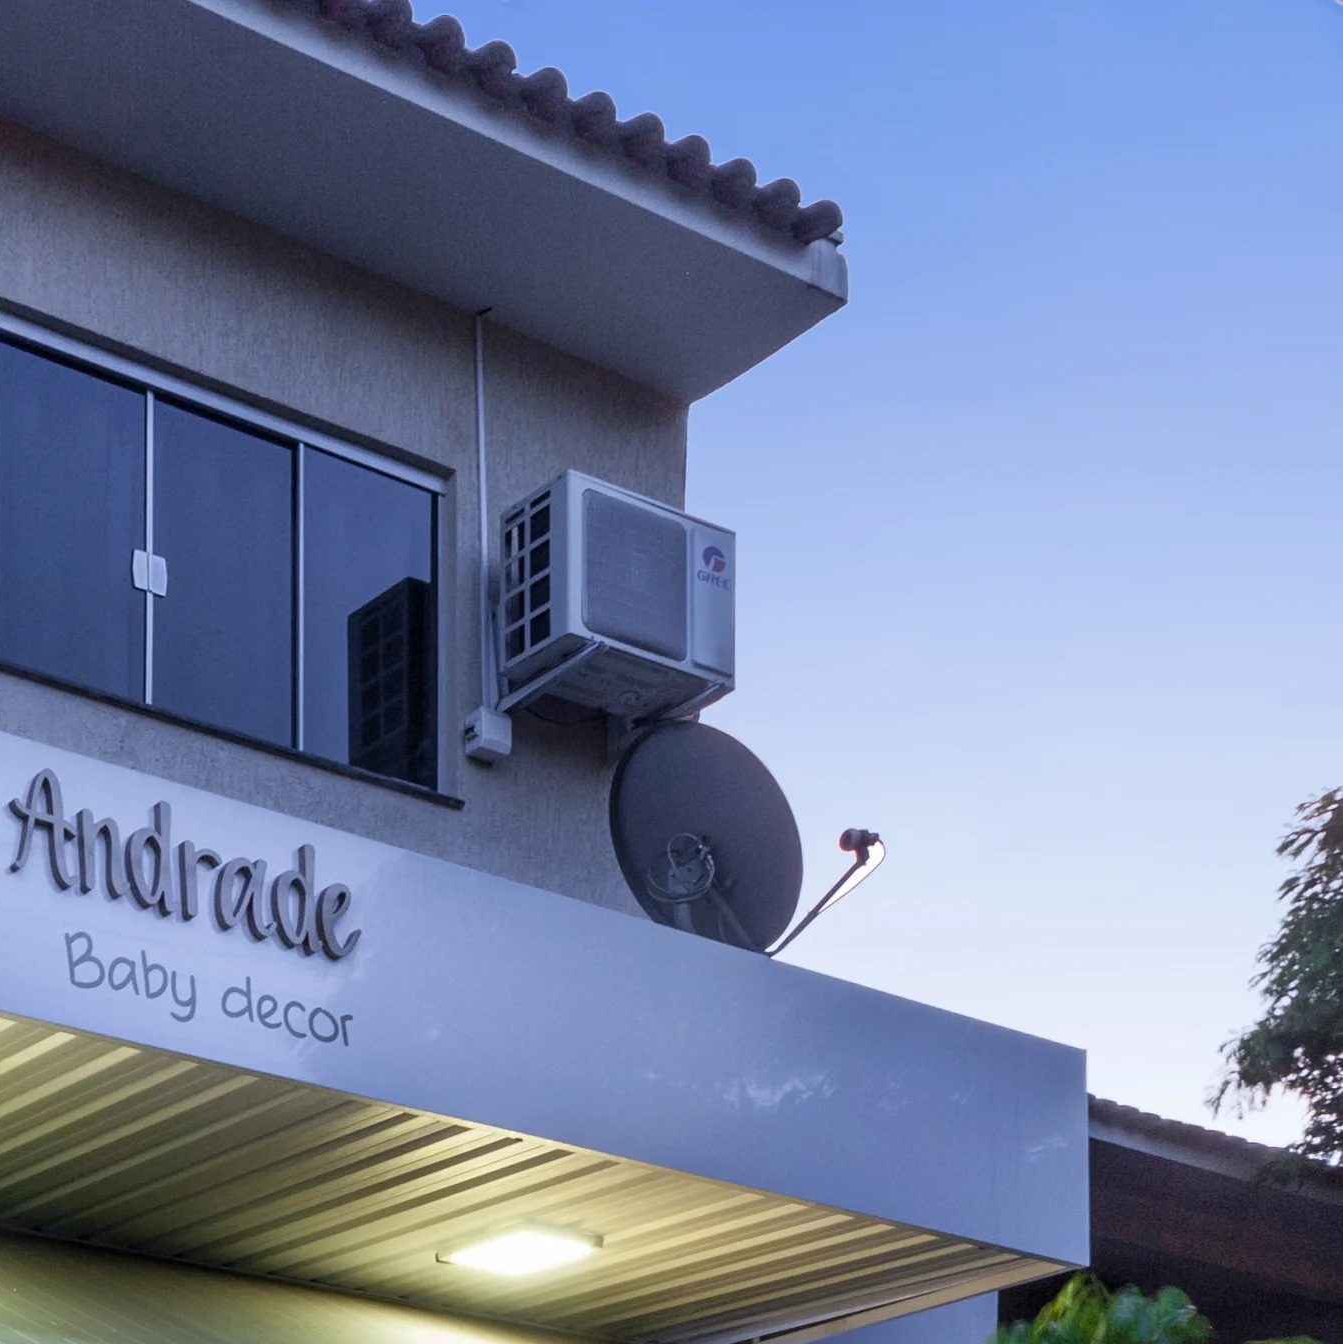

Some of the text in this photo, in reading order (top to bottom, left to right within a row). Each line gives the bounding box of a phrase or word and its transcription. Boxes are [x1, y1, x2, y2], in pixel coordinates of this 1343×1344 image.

[697, 570, 730, 590] GREE
[8, 768, 362, 961] Andrade
[64, 931, 353, 1047] Baby decor
